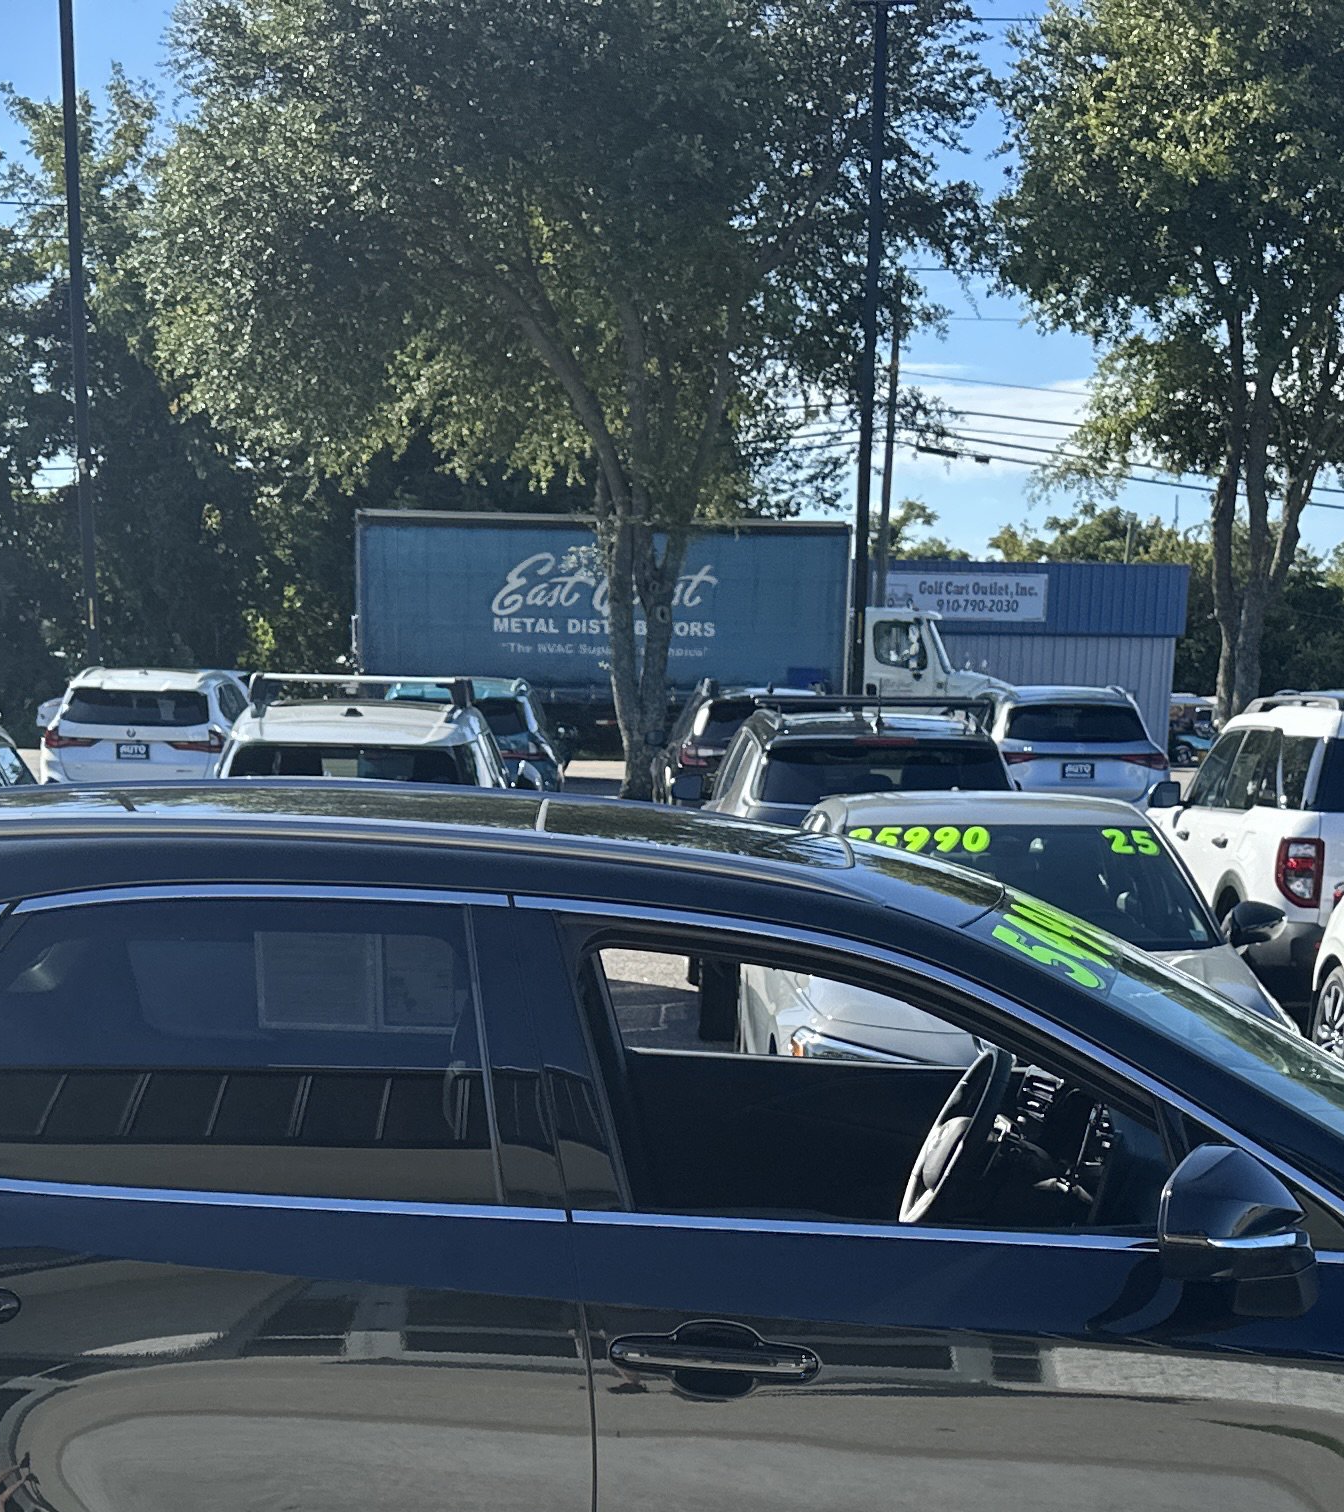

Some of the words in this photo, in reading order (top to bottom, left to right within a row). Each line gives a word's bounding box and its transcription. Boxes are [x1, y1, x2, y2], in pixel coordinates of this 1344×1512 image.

[492, 552, 596, 617] East
[919, 581, 944, 596] Golf
[945, 581, 970, 596] Cart
[1015, 583, 1039, 597] Inc.
[937, 599, 1019, 612] 910-790-2030
[493, 617, 560, 634] METAL
[1101, 828, 1162, 856] 25
